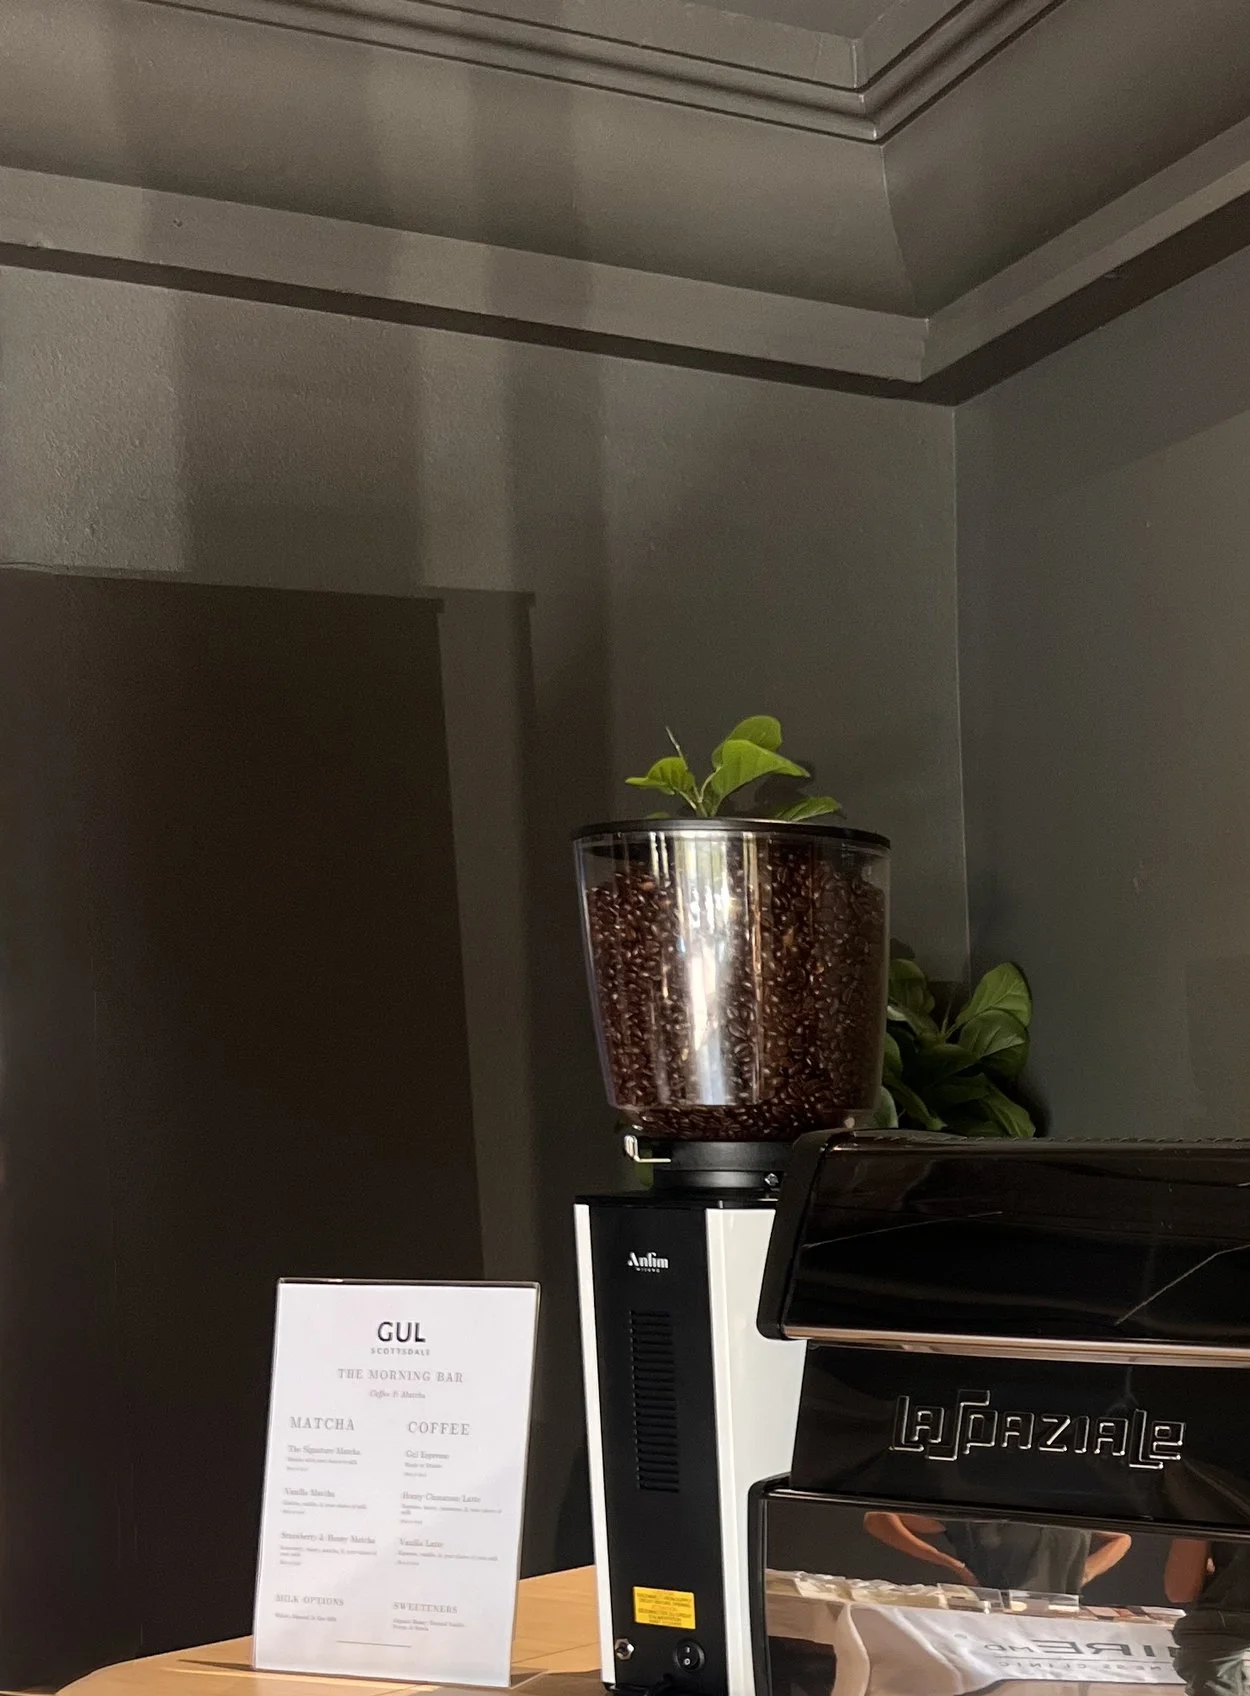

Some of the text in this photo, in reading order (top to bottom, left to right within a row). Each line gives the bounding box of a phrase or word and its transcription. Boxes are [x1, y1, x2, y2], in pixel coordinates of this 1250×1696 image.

[627, 1252, 669, 1269] Anfim
[377, 1321, 427, 1343] GUL
[371, 1347, 430, 1357] SCOTTSDALE
[337, 1367, 464, 1383] THE MORNING BAR
[289, 1416, 355, 1431] MATCHA
[408, 1421, 470, 1436] COFFEE
[275, 1593, 344, 1607] MILK OPTIONS
[392, 1601, 458, 1615] SWEETENERS
